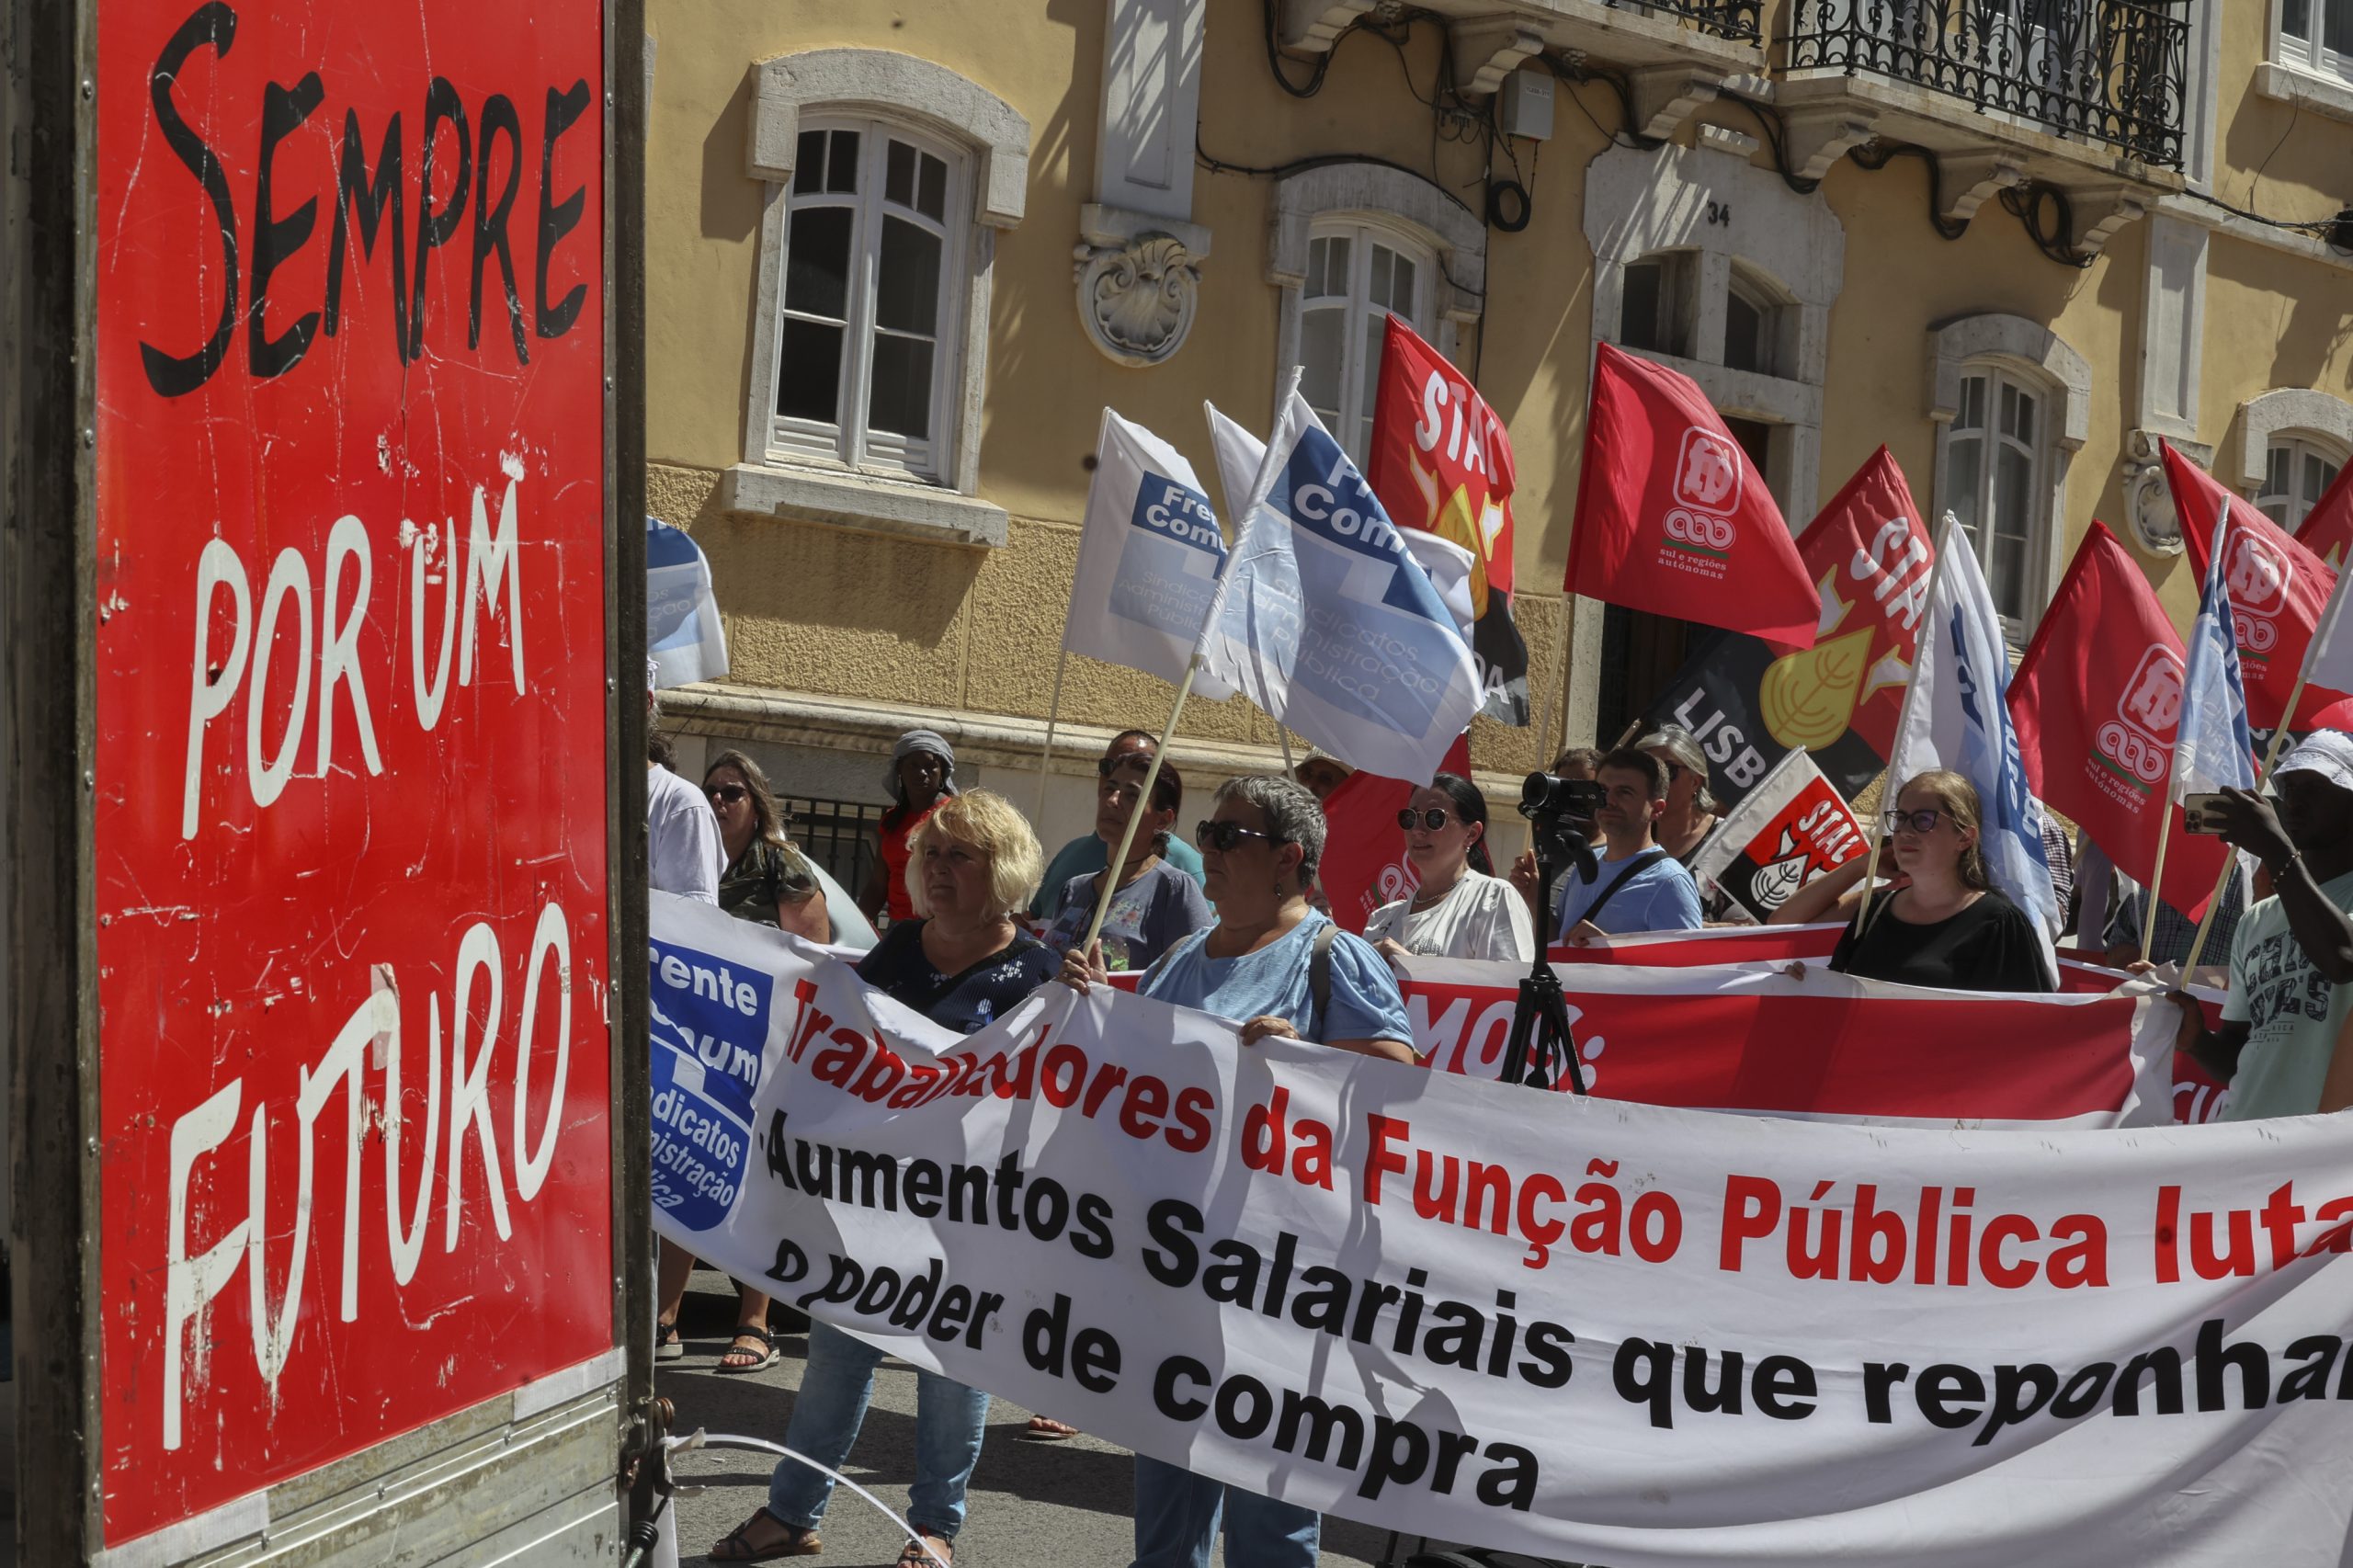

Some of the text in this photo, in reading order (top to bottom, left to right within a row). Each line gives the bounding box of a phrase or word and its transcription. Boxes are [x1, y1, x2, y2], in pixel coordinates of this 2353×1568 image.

[140, 1, 592, 398] SEMPRE
[1707, 200, 1731, 228] 34
[1658, 556, 1724, 580] autónomas
[1688, 554, 1727, 571] regiões
[1850, 517, 1933, 643] STA
[183, 480, 526, 841] POR UM
[2085, 767, 2140, 814] autónomas
[2109, 777, 2147, 805] regiões
[163, 902, 572, 1450] FUTURO
[1241, 1086, 1335, 1192] da
[1363, 1112, 1683, 1270] Função
[1719, 1174, 2110, 1290] Pública
[800, 1252, 1005, 1352] poder
[1021, 1292, 1122, 1394] de
[1153, 1353, 1540, 1513] compra
[1141, 1198, 1576, 1389] Salariais
[1611, 1335, 1818, 1430] que
